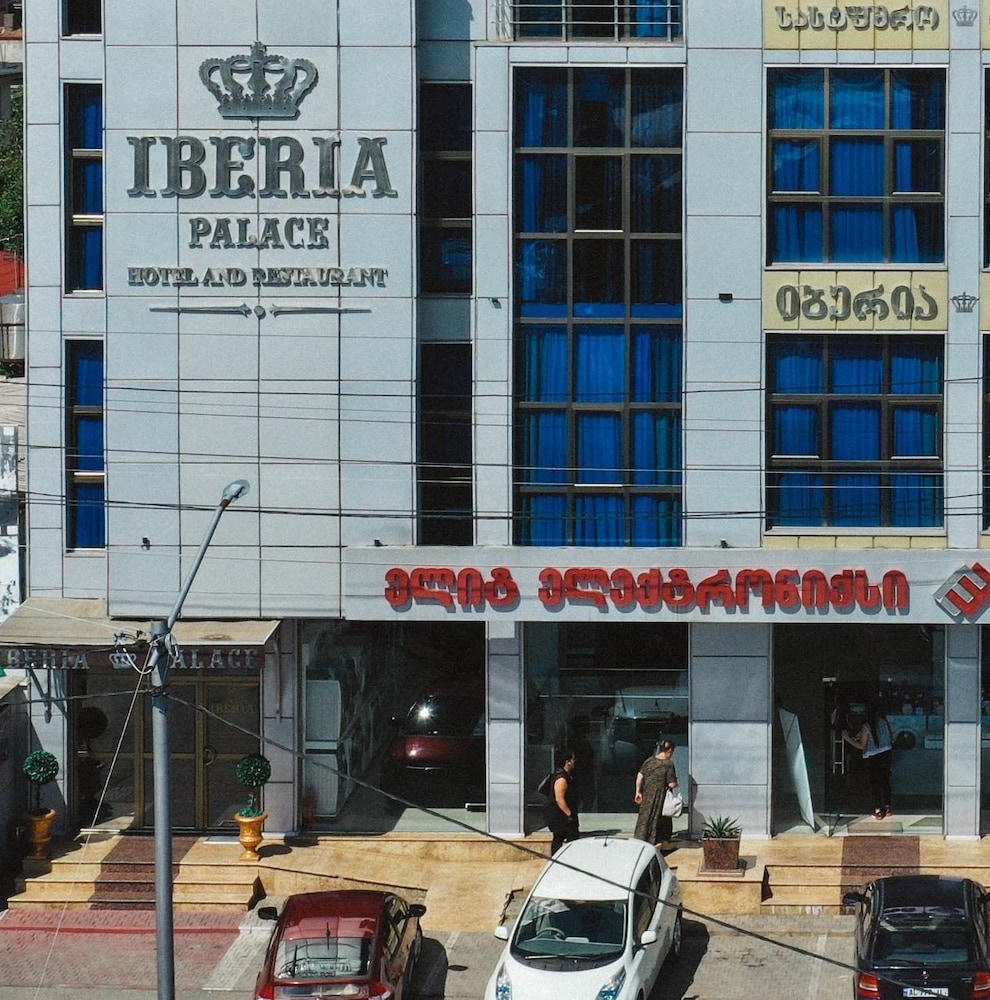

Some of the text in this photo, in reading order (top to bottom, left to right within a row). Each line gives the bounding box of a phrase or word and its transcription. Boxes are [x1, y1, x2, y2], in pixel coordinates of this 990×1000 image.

[126, 135, 399, 199] IBERIA
[188, 216, 331, 250] PALACE
[127, 266, 389, 288] HOTEL AND RESTAURANT
[776, 283, 939, 322] იბერია
[385, 567, 519, 611] ელიტ
[169, 648, 259, 669] ALACE
